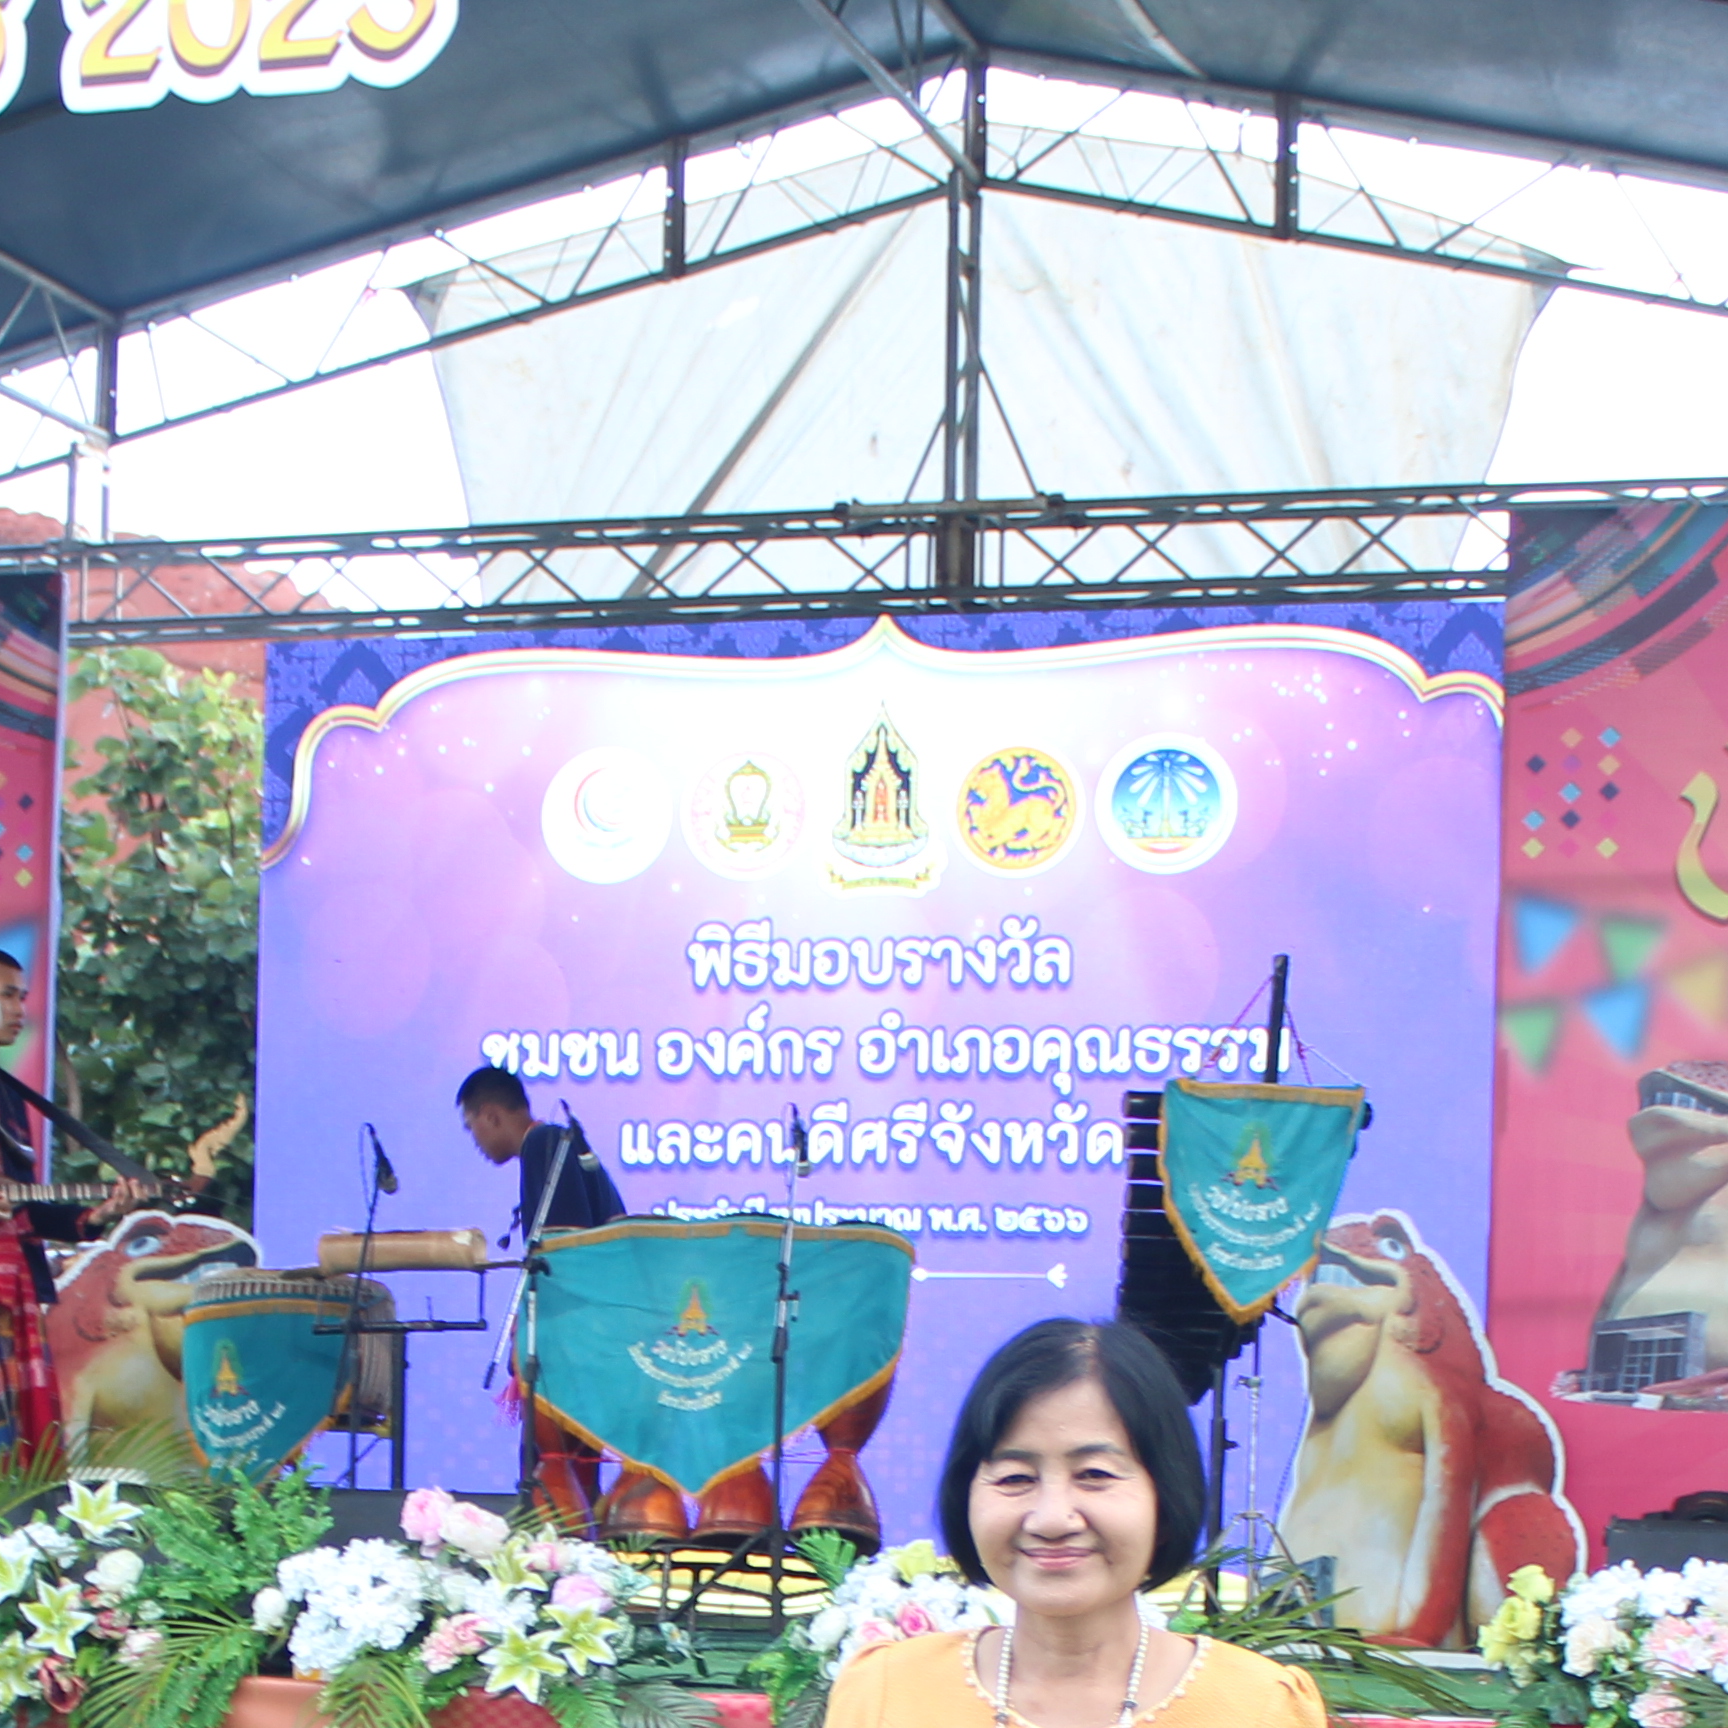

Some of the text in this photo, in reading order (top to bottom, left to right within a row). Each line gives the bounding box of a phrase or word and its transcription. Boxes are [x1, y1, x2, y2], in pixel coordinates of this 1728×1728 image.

[687, 914, 1072, 988] พิธีมอบรางวัล
[481, 1000, 1291, 1097] ชมชน องค์กร อำเภอคุณธรรม
[927, 1206, 988, 1233] พ.ศ.
[993, 1206, 1090, 1235] ๒๕๖๖
